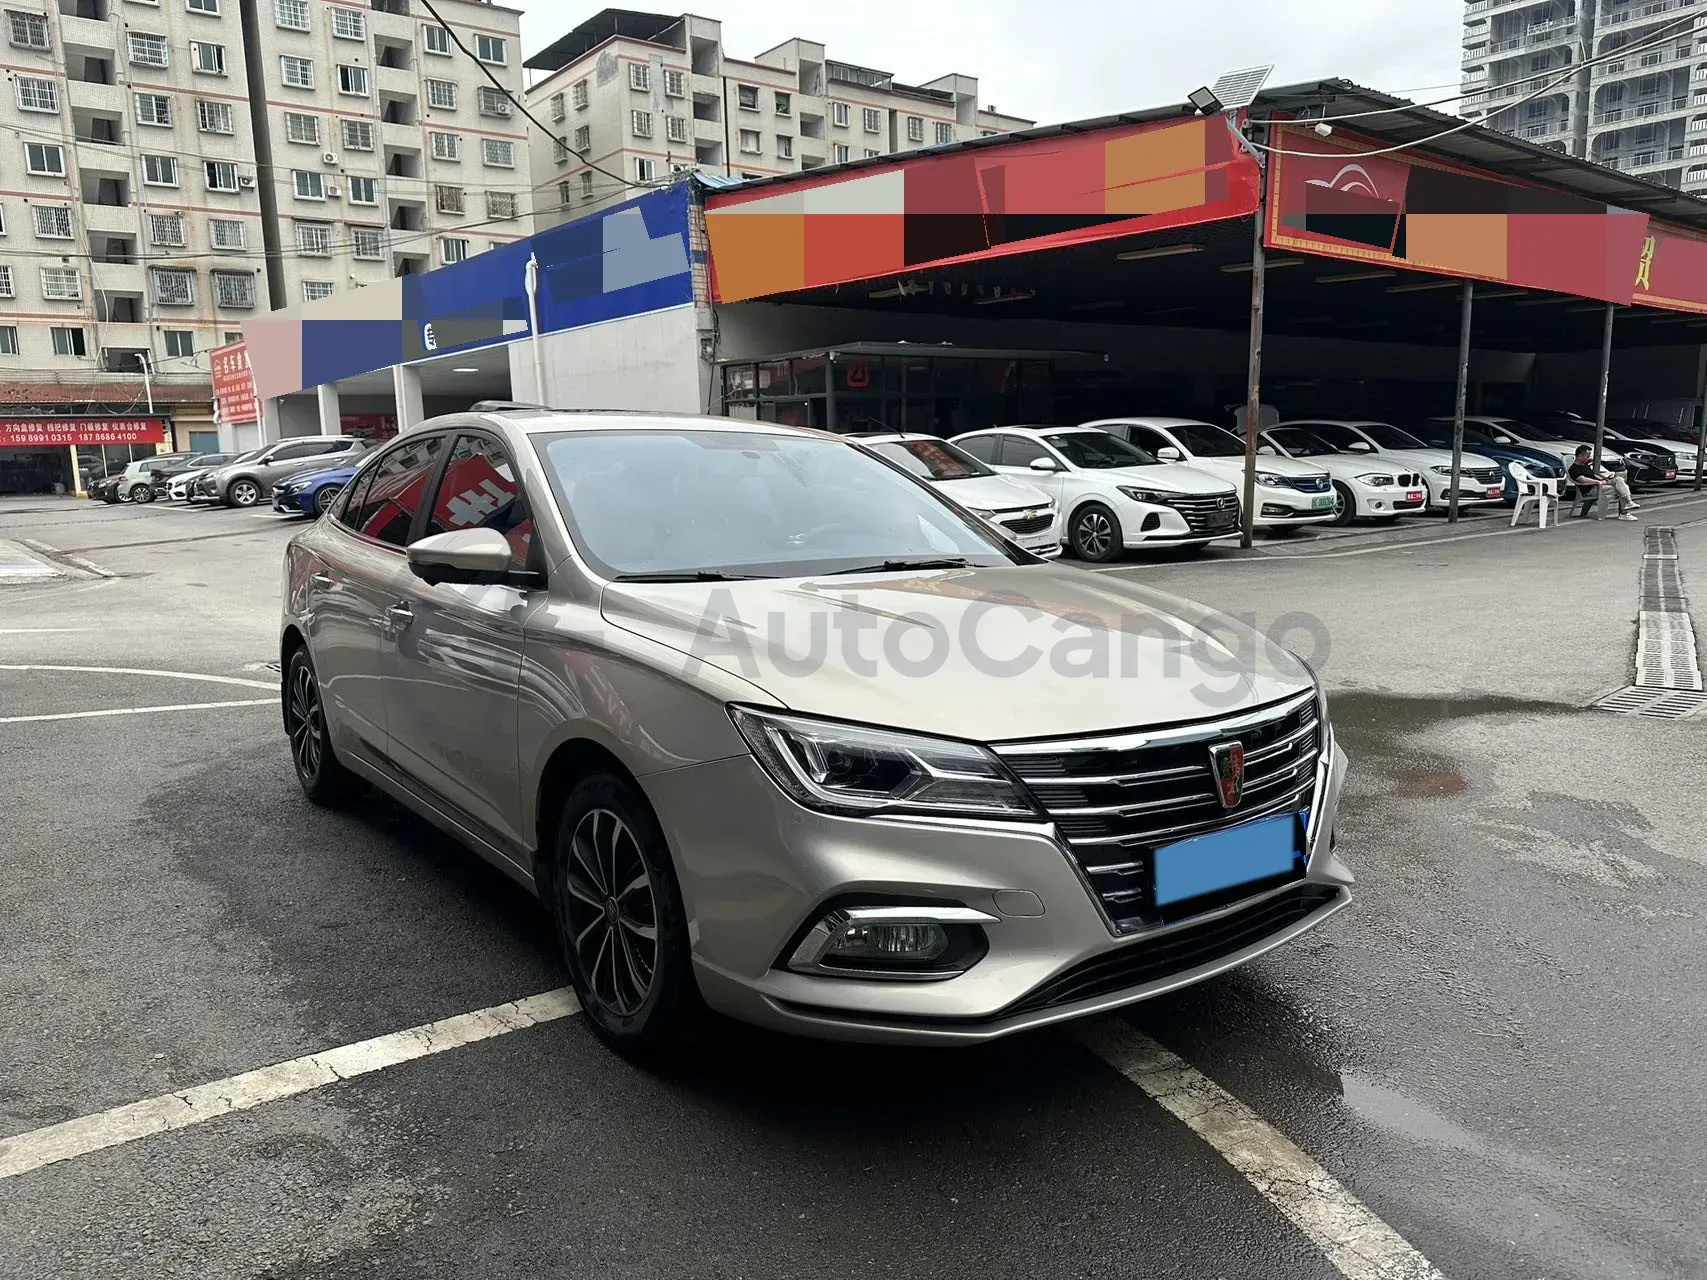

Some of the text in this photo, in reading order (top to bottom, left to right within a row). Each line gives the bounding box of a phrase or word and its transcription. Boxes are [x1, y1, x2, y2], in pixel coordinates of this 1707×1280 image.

[5, 423, 43, 432] 方向盘修复
[80, 422, 108, 432] 门板修复
[112, 422, 147, 431] 仪表台修复
[10, 434, 26, 442] 159
[28, 434, 49, 442] 8991
[51, 433, 72, 441] 0315
[79, 433, 94, 441] 187
[95, 433, 116, 441] 8686
